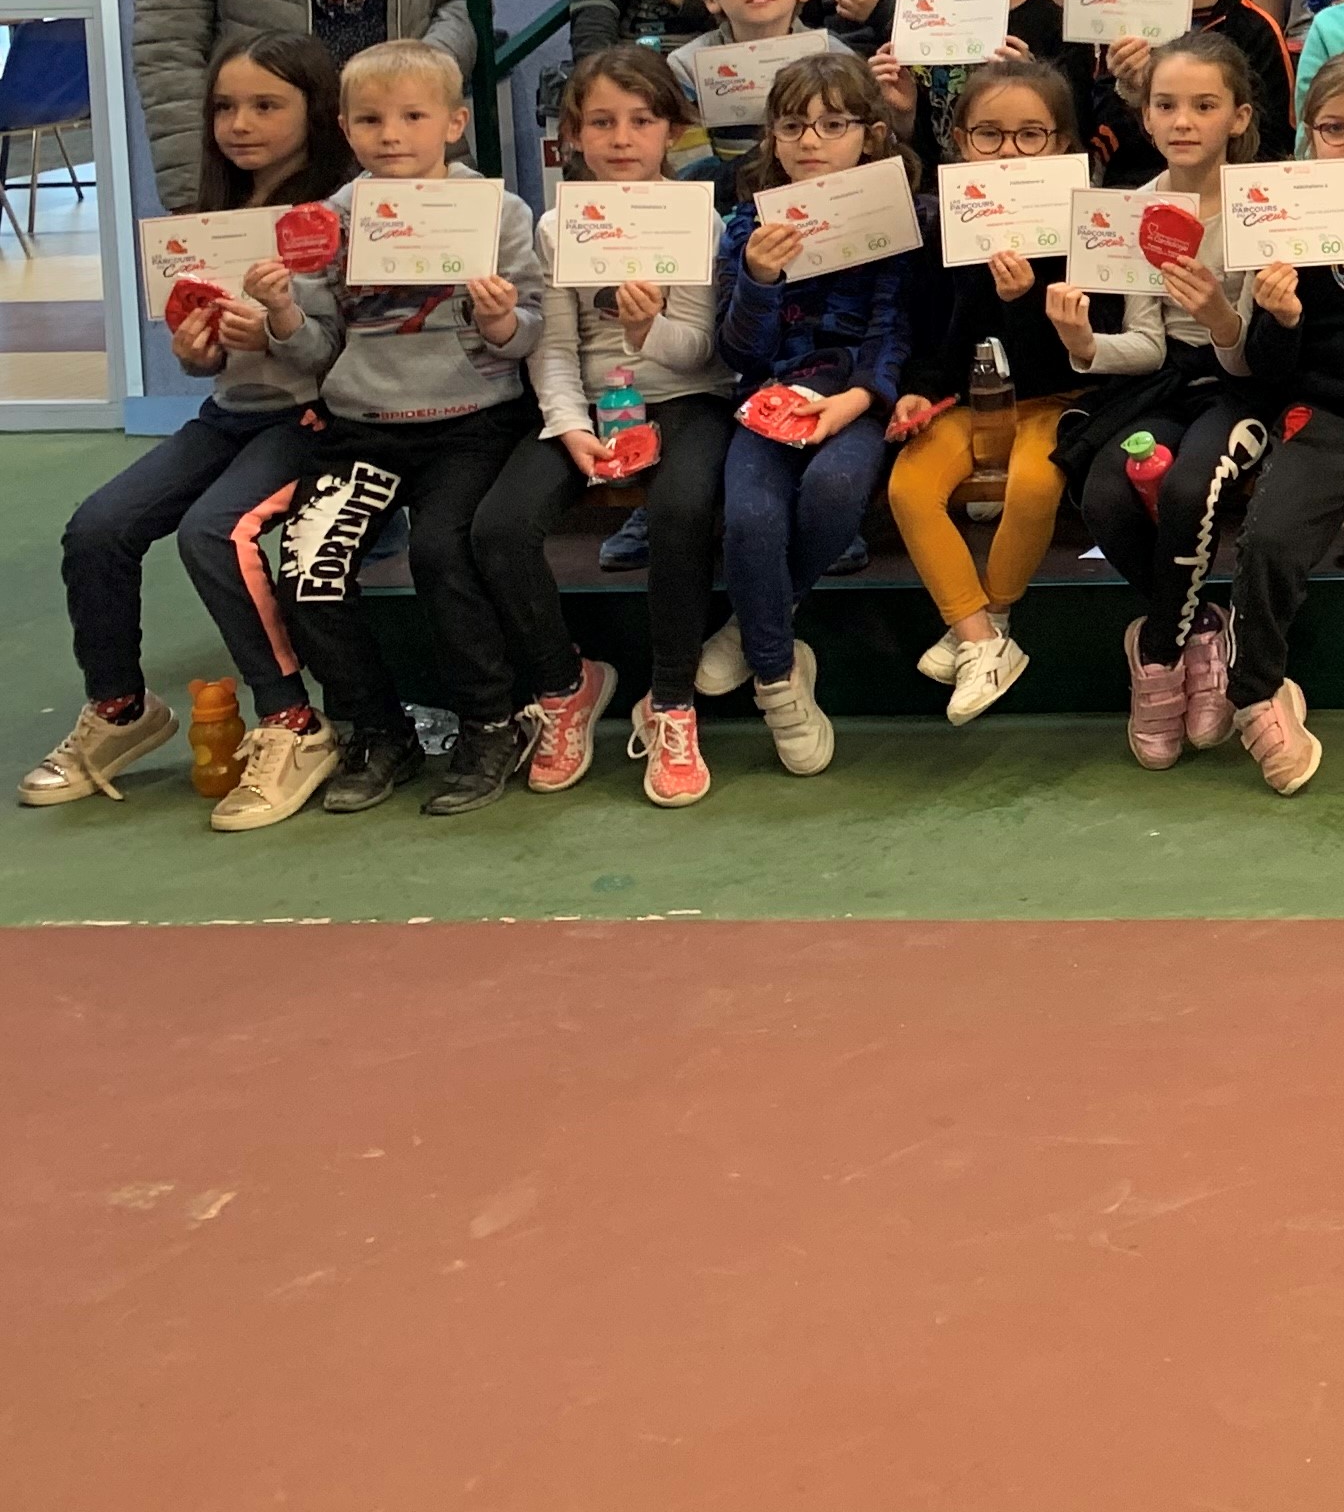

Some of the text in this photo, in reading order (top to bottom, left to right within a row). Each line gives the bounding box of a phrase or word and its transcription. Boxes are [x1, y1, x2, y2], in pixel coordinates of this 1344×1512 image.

[1142, 26, 1160, 37] 60
[967, 42, 983, 54] 60
[1232, 204, 1278, 214] PARCOURS
[565, 222, 613, 231] PARCOURS
[867, 236, 888, 251] 60
[1010, 233, 1058, 249] 5 60
[1294, 242, 1303, 256] 5
[1321, 240, 1340, 254] 60
[415, 260, 461, 274] 5 60
[626, 261, 676, 275] 5 60
[1126, 271, 1164, 286] 5 60
[381, 403, 480, 421] SPIDER-MAN
[300, 464, 398, 600] FORTNITE
